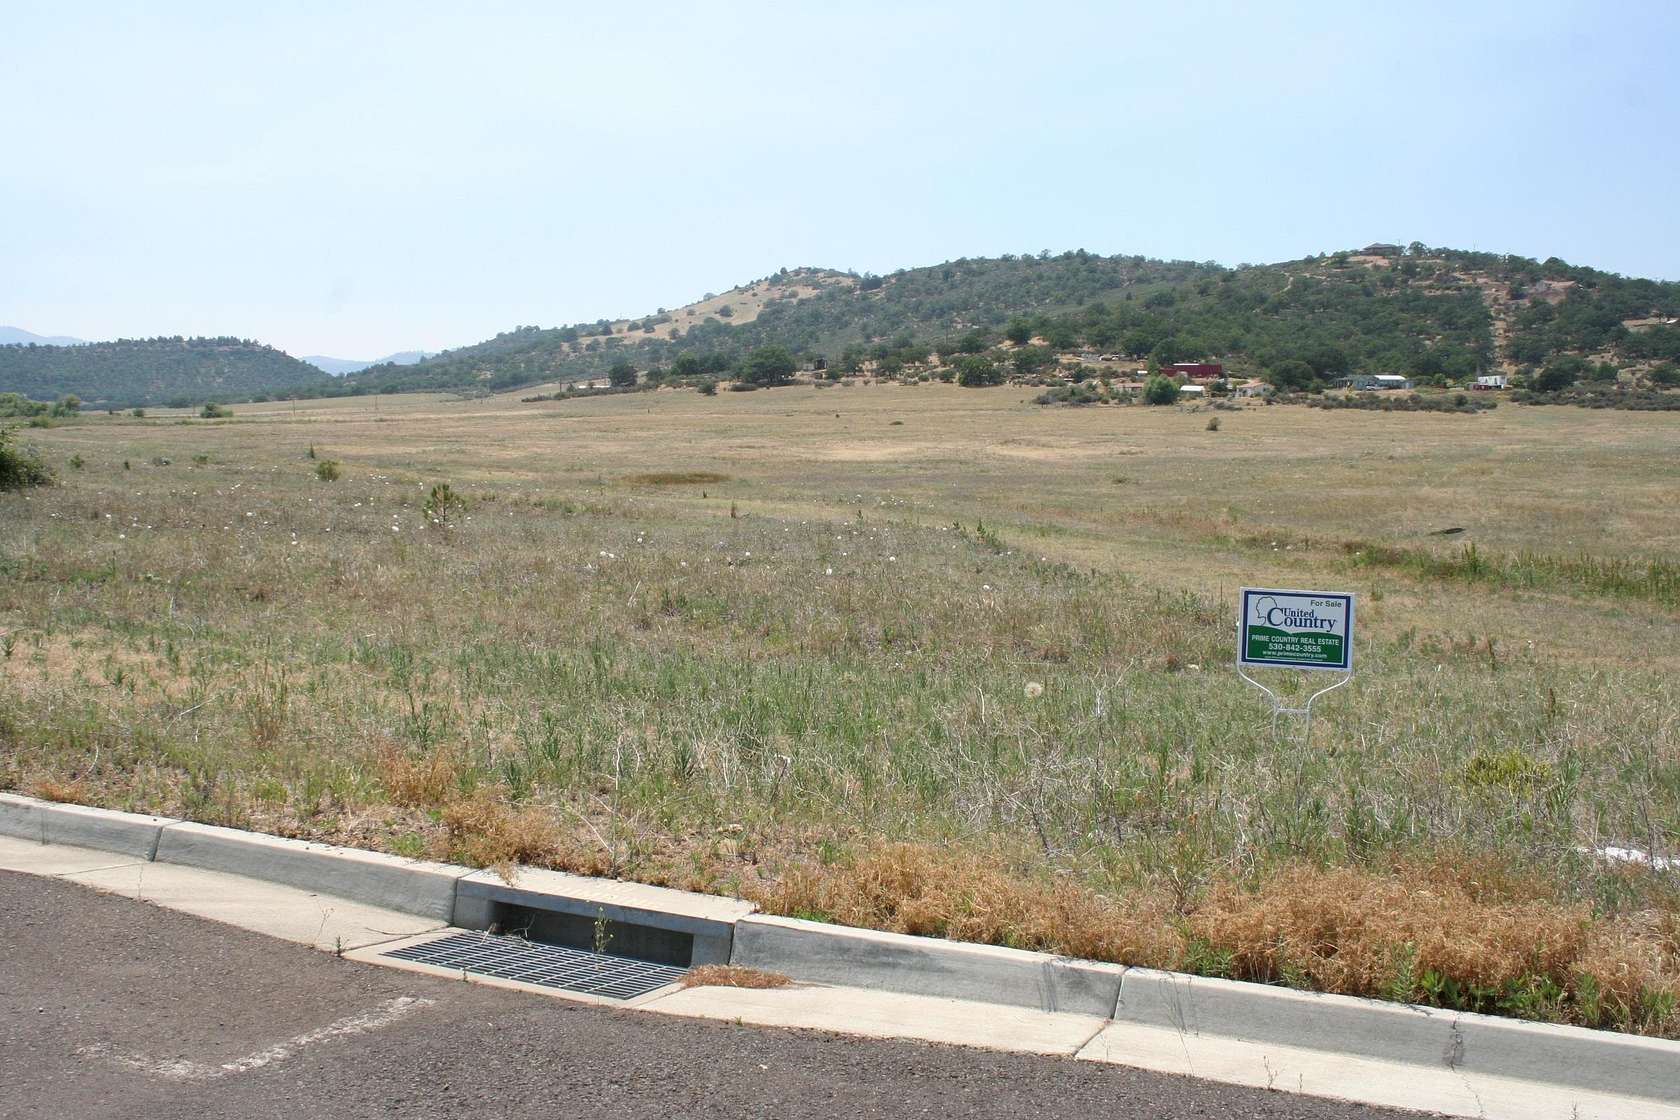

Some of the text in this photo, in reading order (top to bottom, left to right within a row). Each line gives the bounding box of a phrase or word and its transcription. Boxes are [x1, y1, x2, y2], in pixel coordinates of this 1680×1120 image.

[1325, 600, 1342, 608] Sale
[1284, 607, 1315, 618] United
[1267, 607, 1337, 632] Country
[1252, 634, 1340, 646] PRIME COUNTRY REAL ESTATE
[1269, 643, 1322, 653] 530-842-3555
